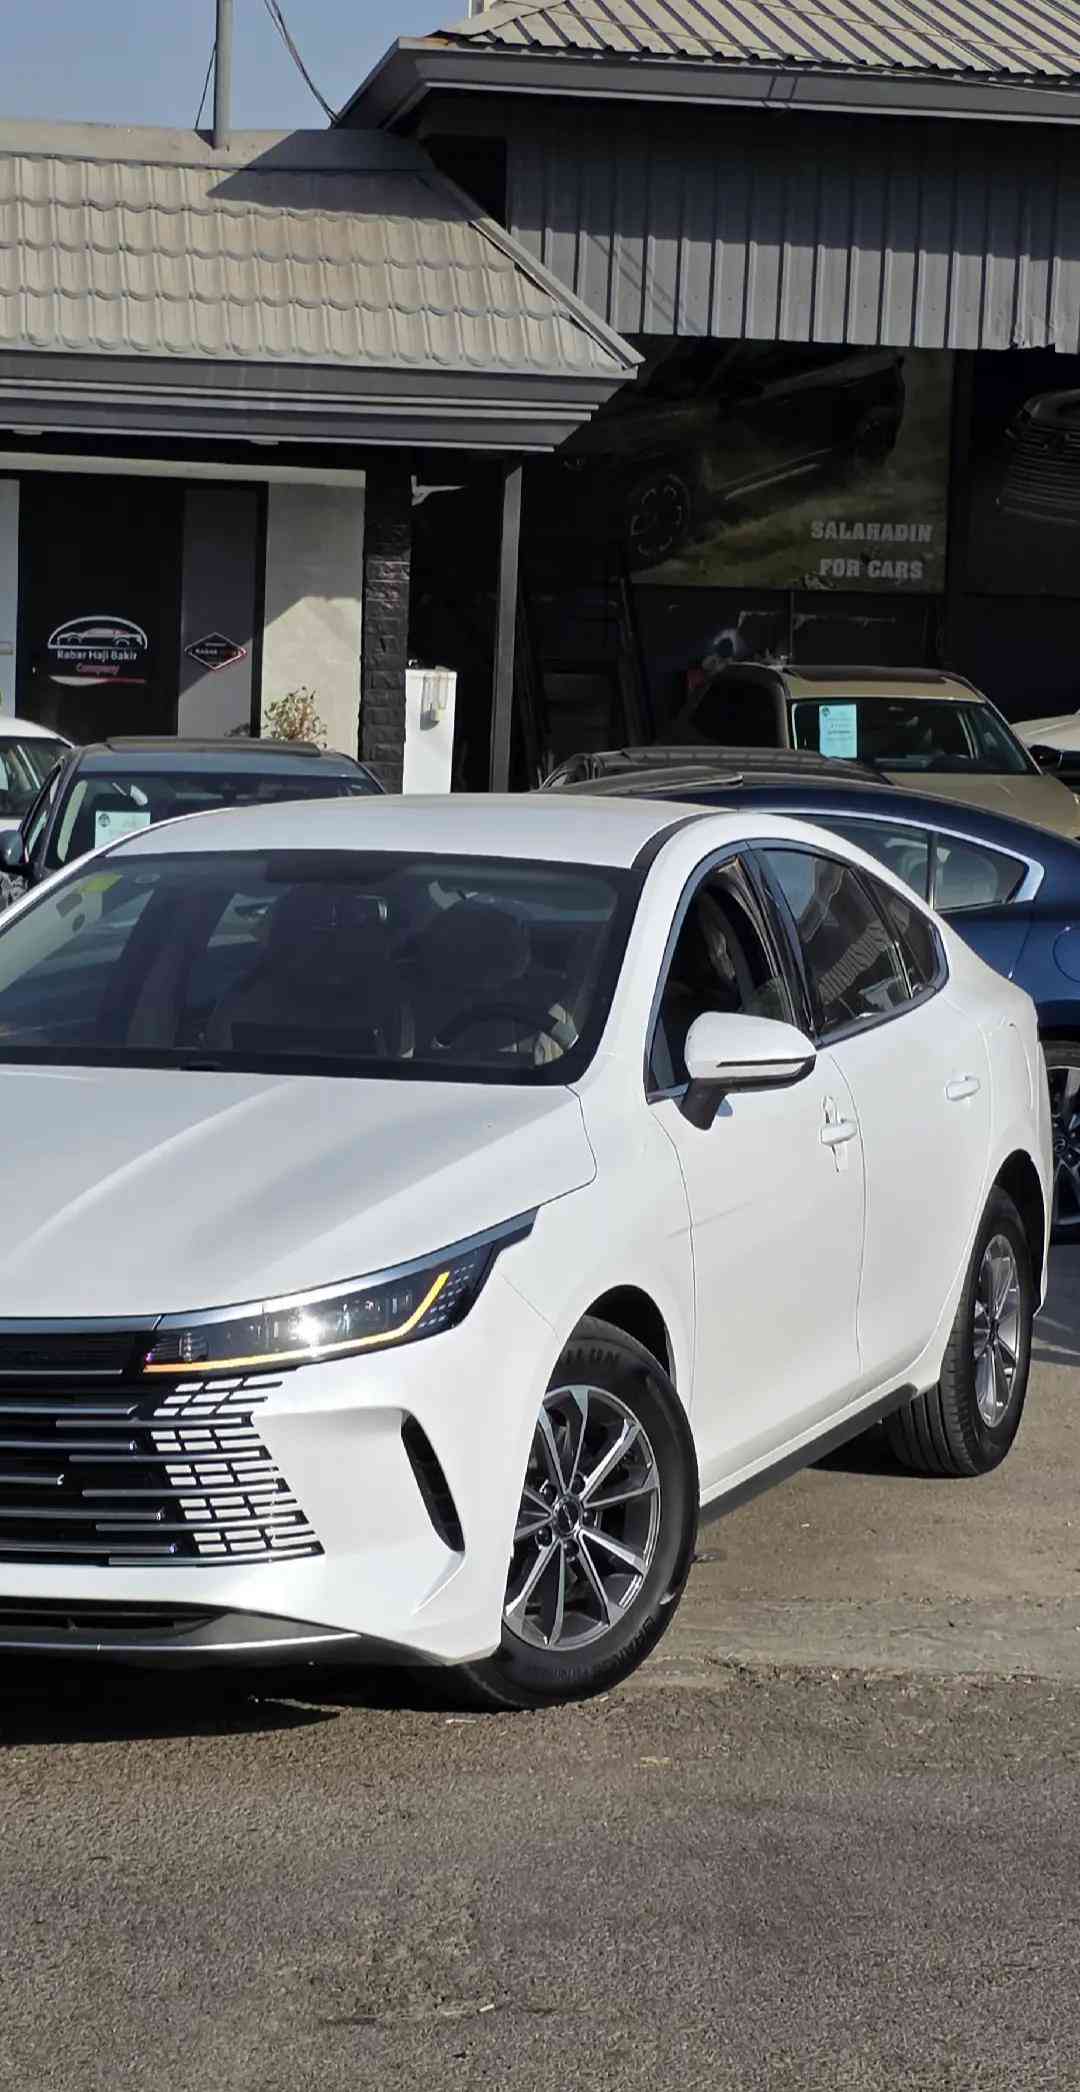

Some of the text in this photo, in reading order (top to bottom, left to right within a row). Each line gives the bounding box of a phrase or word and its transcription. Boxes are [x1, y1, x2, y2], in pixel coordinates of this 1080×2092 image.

[819, 558, 923, 579] FOR CARS
[88, 650, 109, 662] Haji
